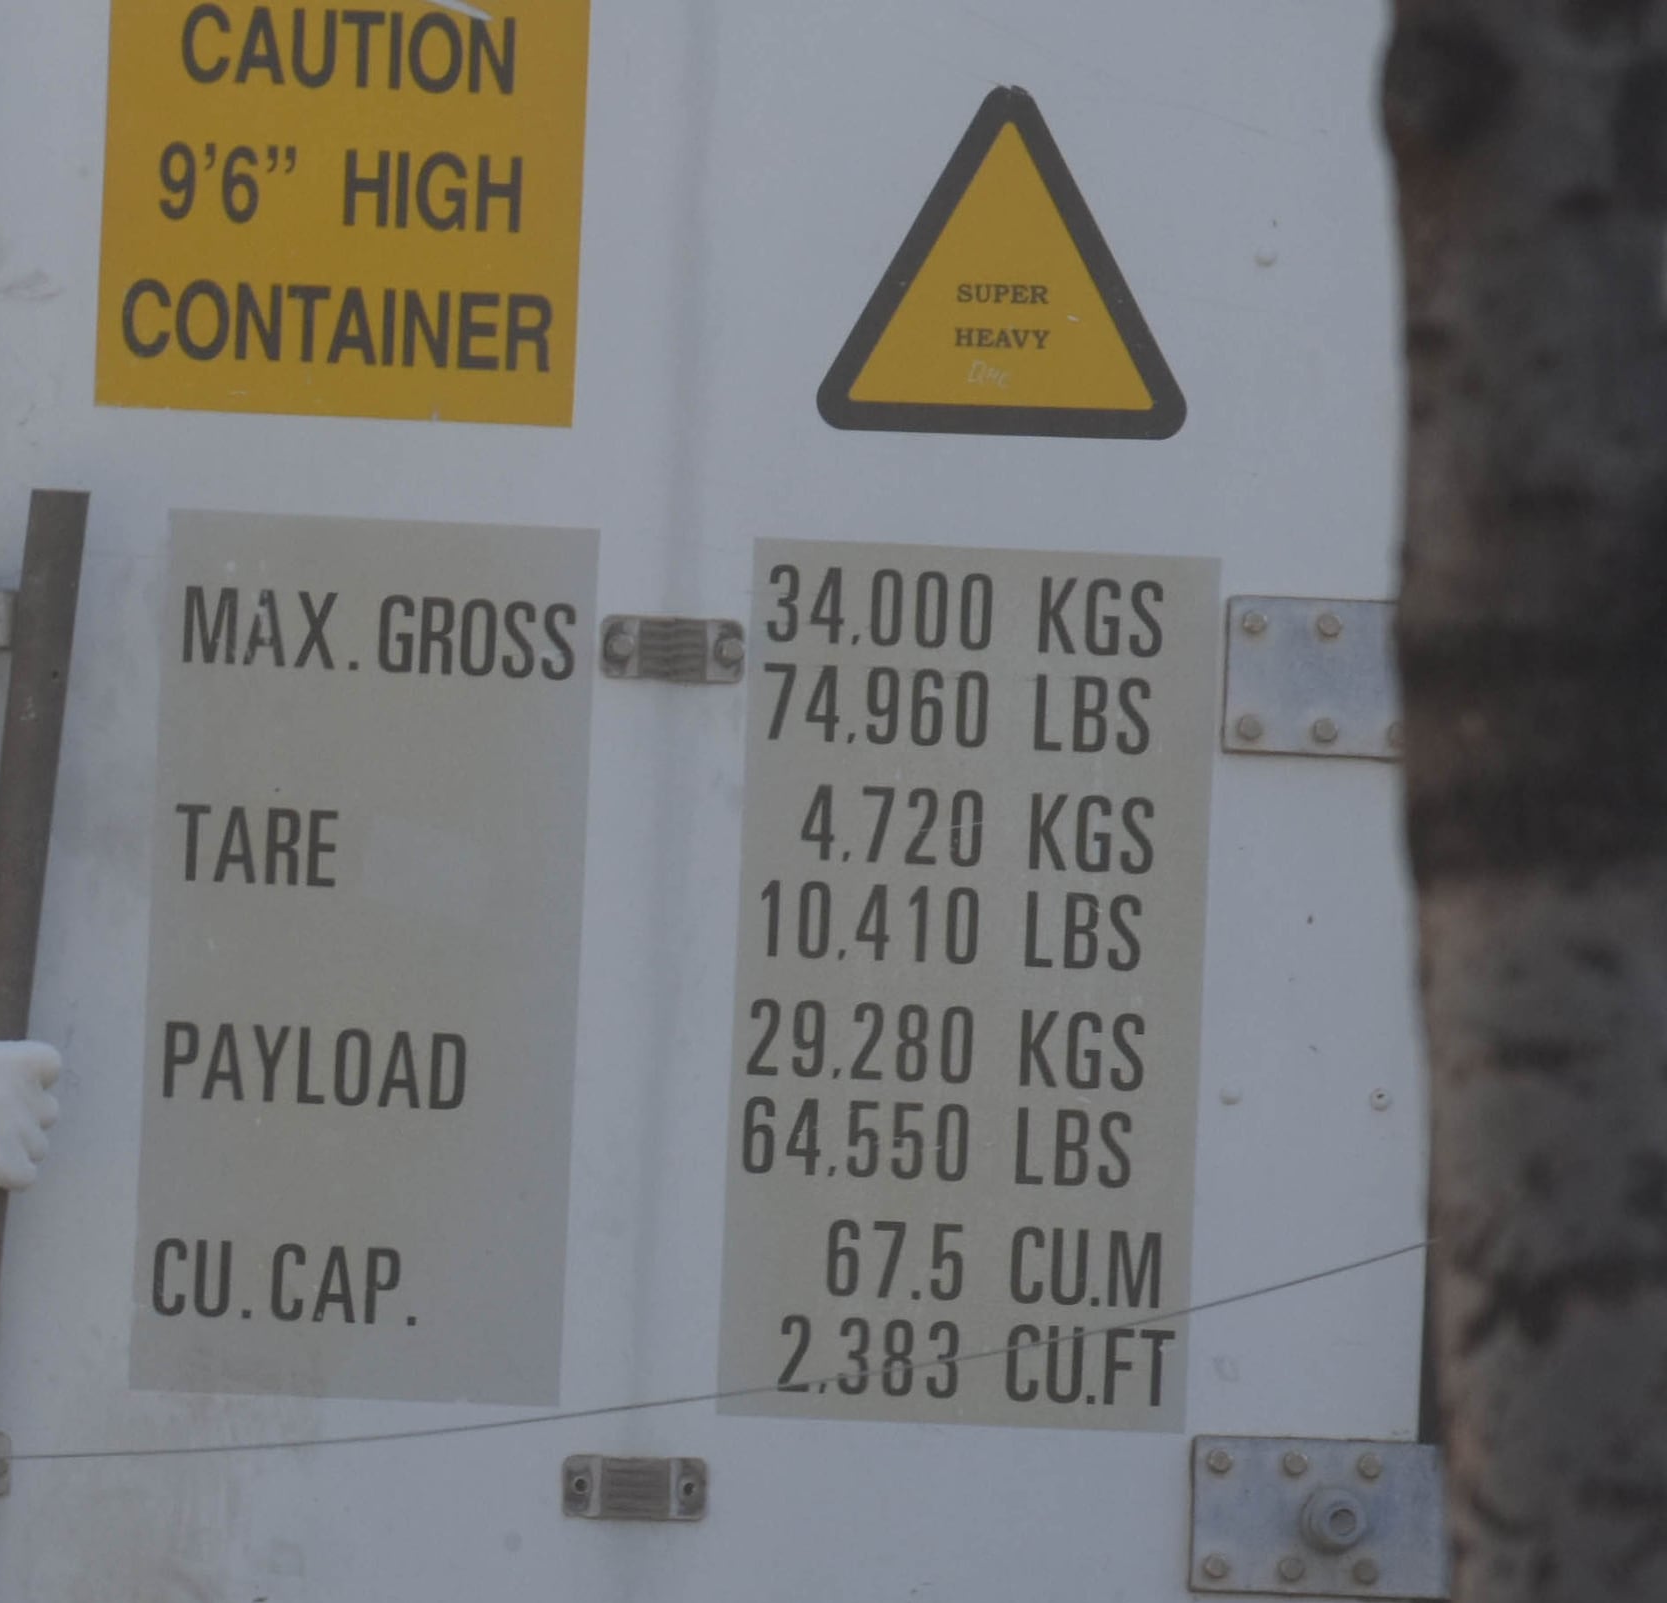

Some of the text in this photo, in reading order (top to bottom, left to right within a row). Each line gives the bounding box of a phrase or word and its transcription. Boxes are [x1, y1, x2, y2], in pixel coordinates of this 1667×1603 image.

[181, 3, 516, 96] CAUTION
[342, 148, 523, 234] HIGH
[121, 278, 553, 373] CONTAINER
[954, 326, 1051, 350] HEAVY
[956, 283, 1049, 305] SUPER
[766, 564, 1164, 658] 34,000 KGS
[763, 662, 1151, 756] 74,960 LBS
[175, 803, 339, 888] TARE
[800, 784, 1155, 875] 4,720 KGS
[761, 879, 1142, 972] 10,410 LBS
[162, 1020, 467, 1110] PAYLOAD
[746, 998, 1145, 1092] 29,280 KGS
[742, 1095, 1132, 1189] 64,550 LBS
[826, 1218, 964, 1301] 67.5
[776, 1314, 960, 1399] 2,383
